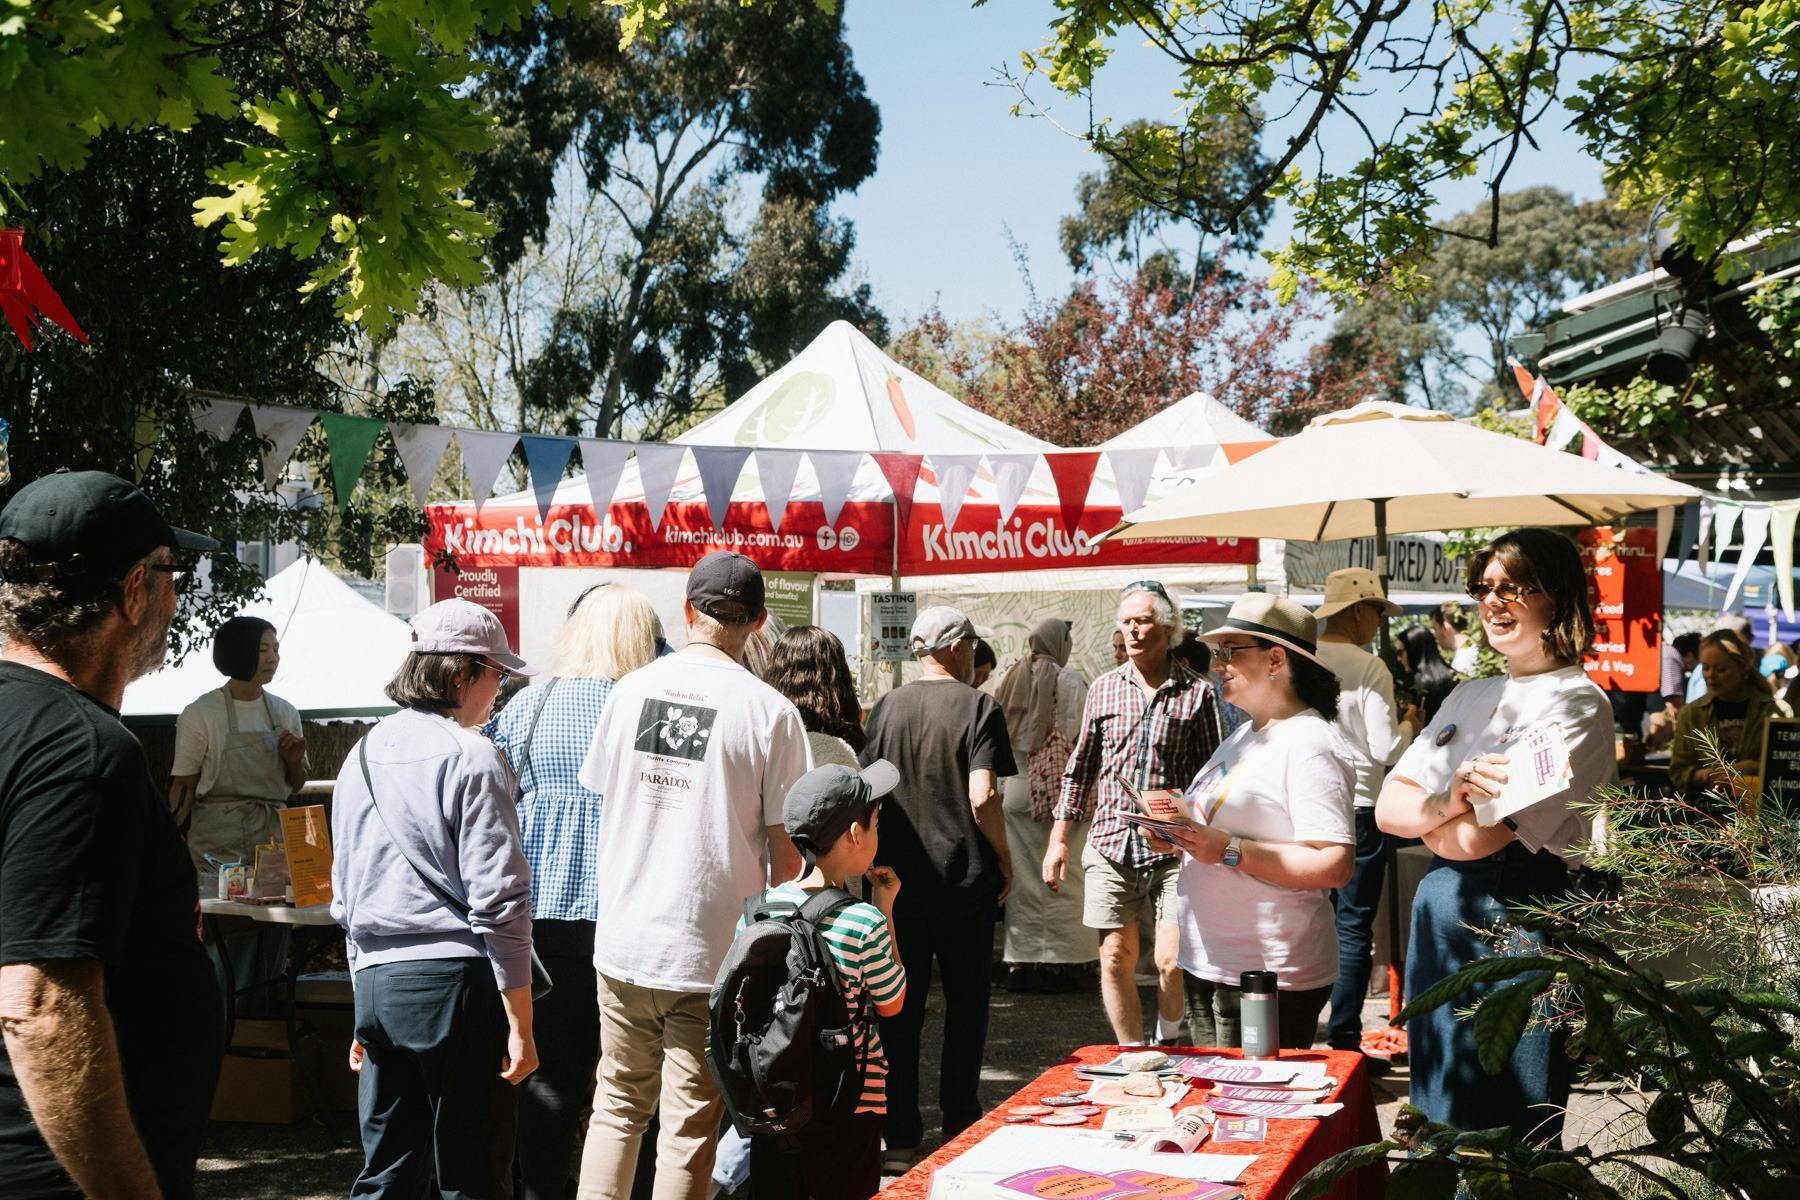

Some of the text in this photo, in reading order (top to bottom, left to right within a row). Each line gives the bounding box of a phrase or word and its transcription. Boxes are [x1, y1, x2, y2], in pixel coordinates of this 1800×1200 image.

[444, 514, 632, 554] Kimchi Club.
[665, 525, 804, 548] kimchiclub.com.au
[922, 517, 1100, 561] Kimchi Club.
[1349, 538, 1427, 582] CULURED
[458, 568, 497, 584] Proudly
[768, 577, 778, 589] of
[779, 578, 809, 592] flavour
[454, 583, 501, 597] Certified
[872, 594, 915, 603] TASTING
[1612, 660, 1634, 675] Veg
[640, 771, 690, 790] PARADOX
